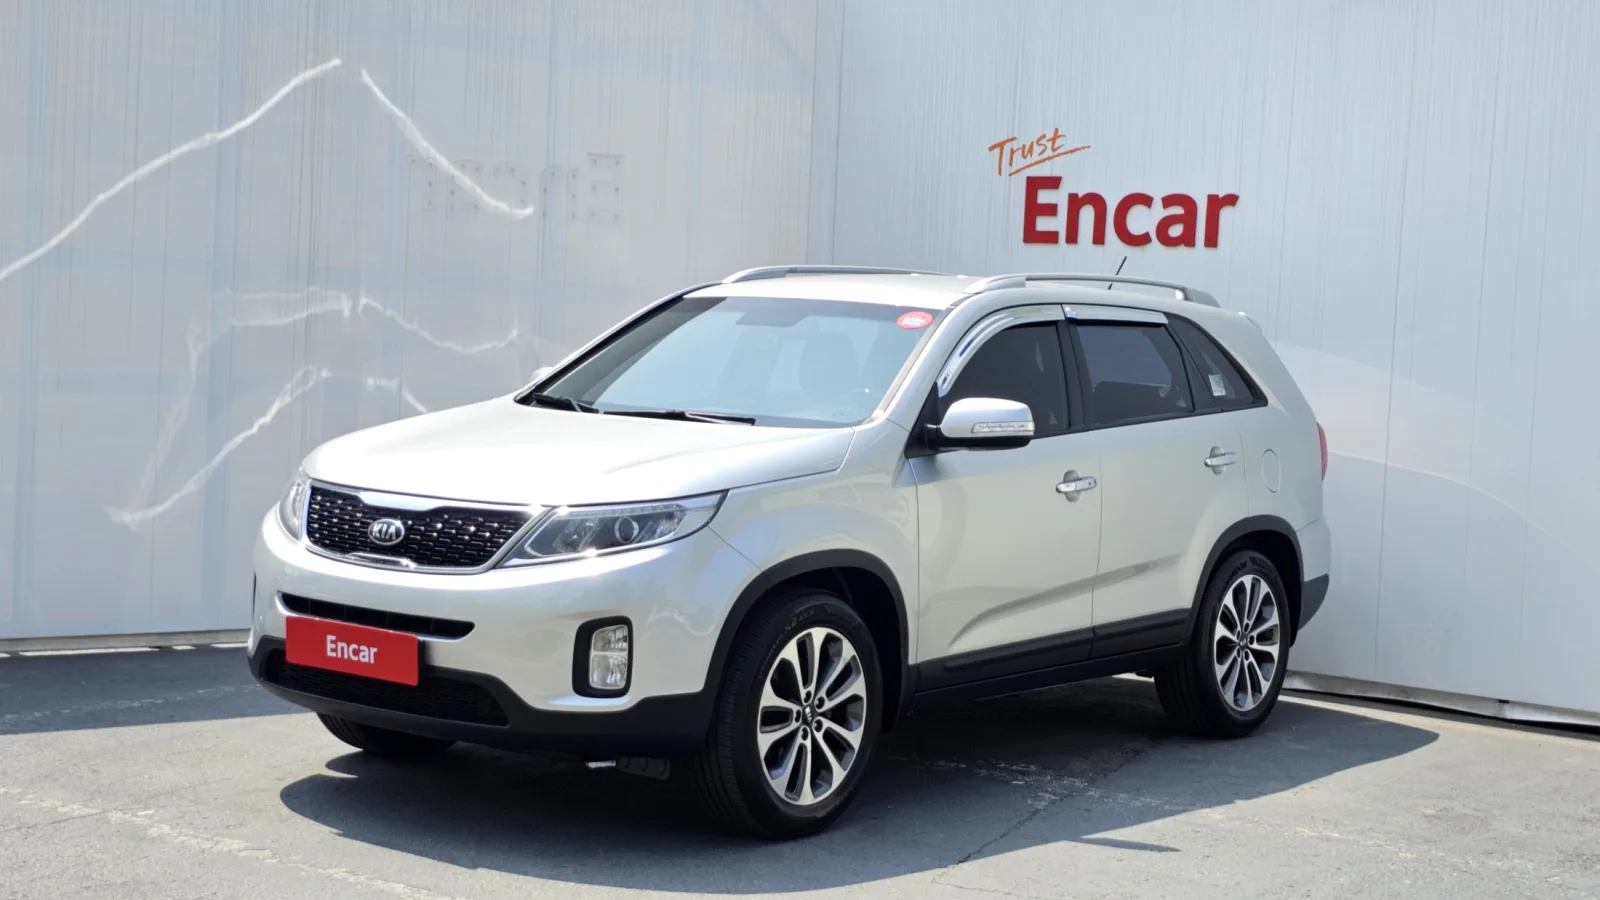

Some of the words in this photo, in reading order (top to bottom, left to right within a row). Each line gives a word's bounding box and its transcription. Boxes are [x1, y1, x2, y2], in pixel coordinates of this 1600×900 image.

[988, 128, 1066, 176] Trust
[1023, 176, 1239, 248] Encar
[372, 523, 396, 540] KIA
[326, 634, 378, 664] Encar
